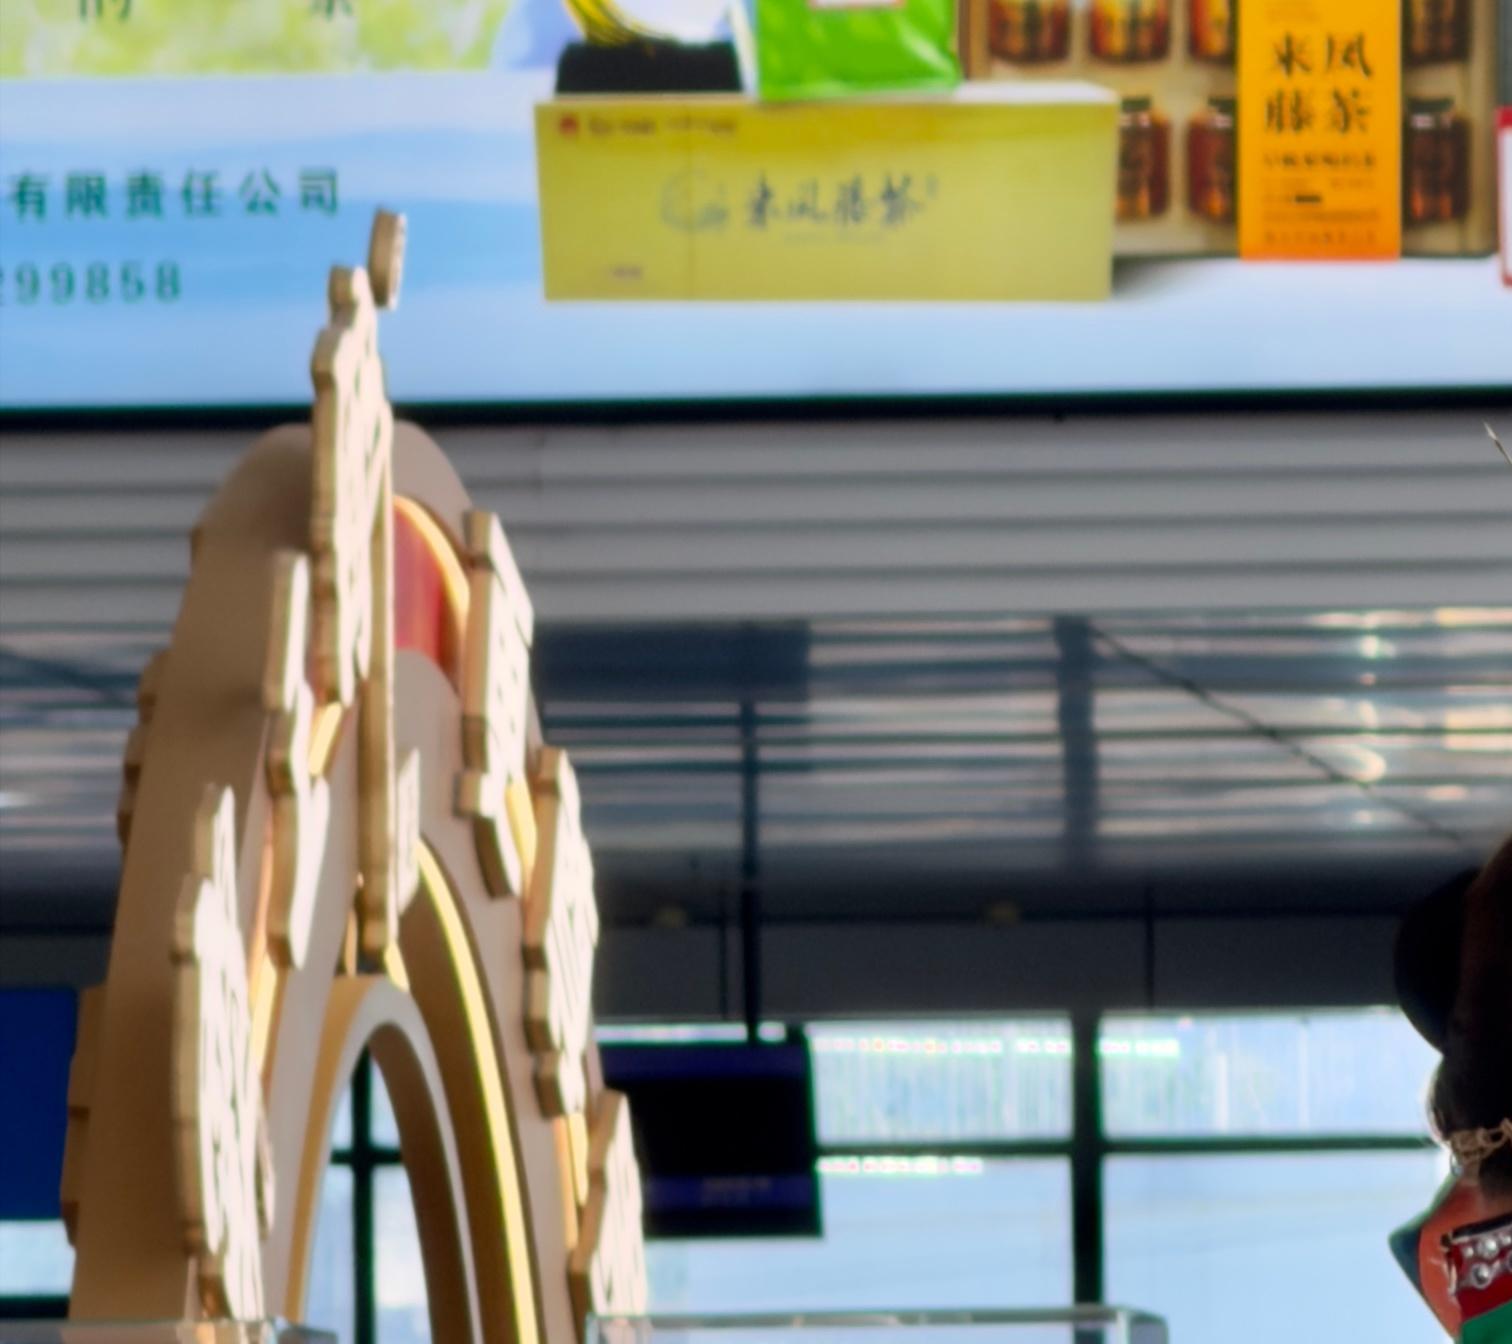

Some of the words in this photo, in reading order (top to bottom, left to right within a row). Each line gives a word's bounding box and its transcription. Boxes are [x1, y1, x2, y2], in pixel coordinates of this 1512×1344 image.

[12, 168, 341, 221] 有限责任公司
